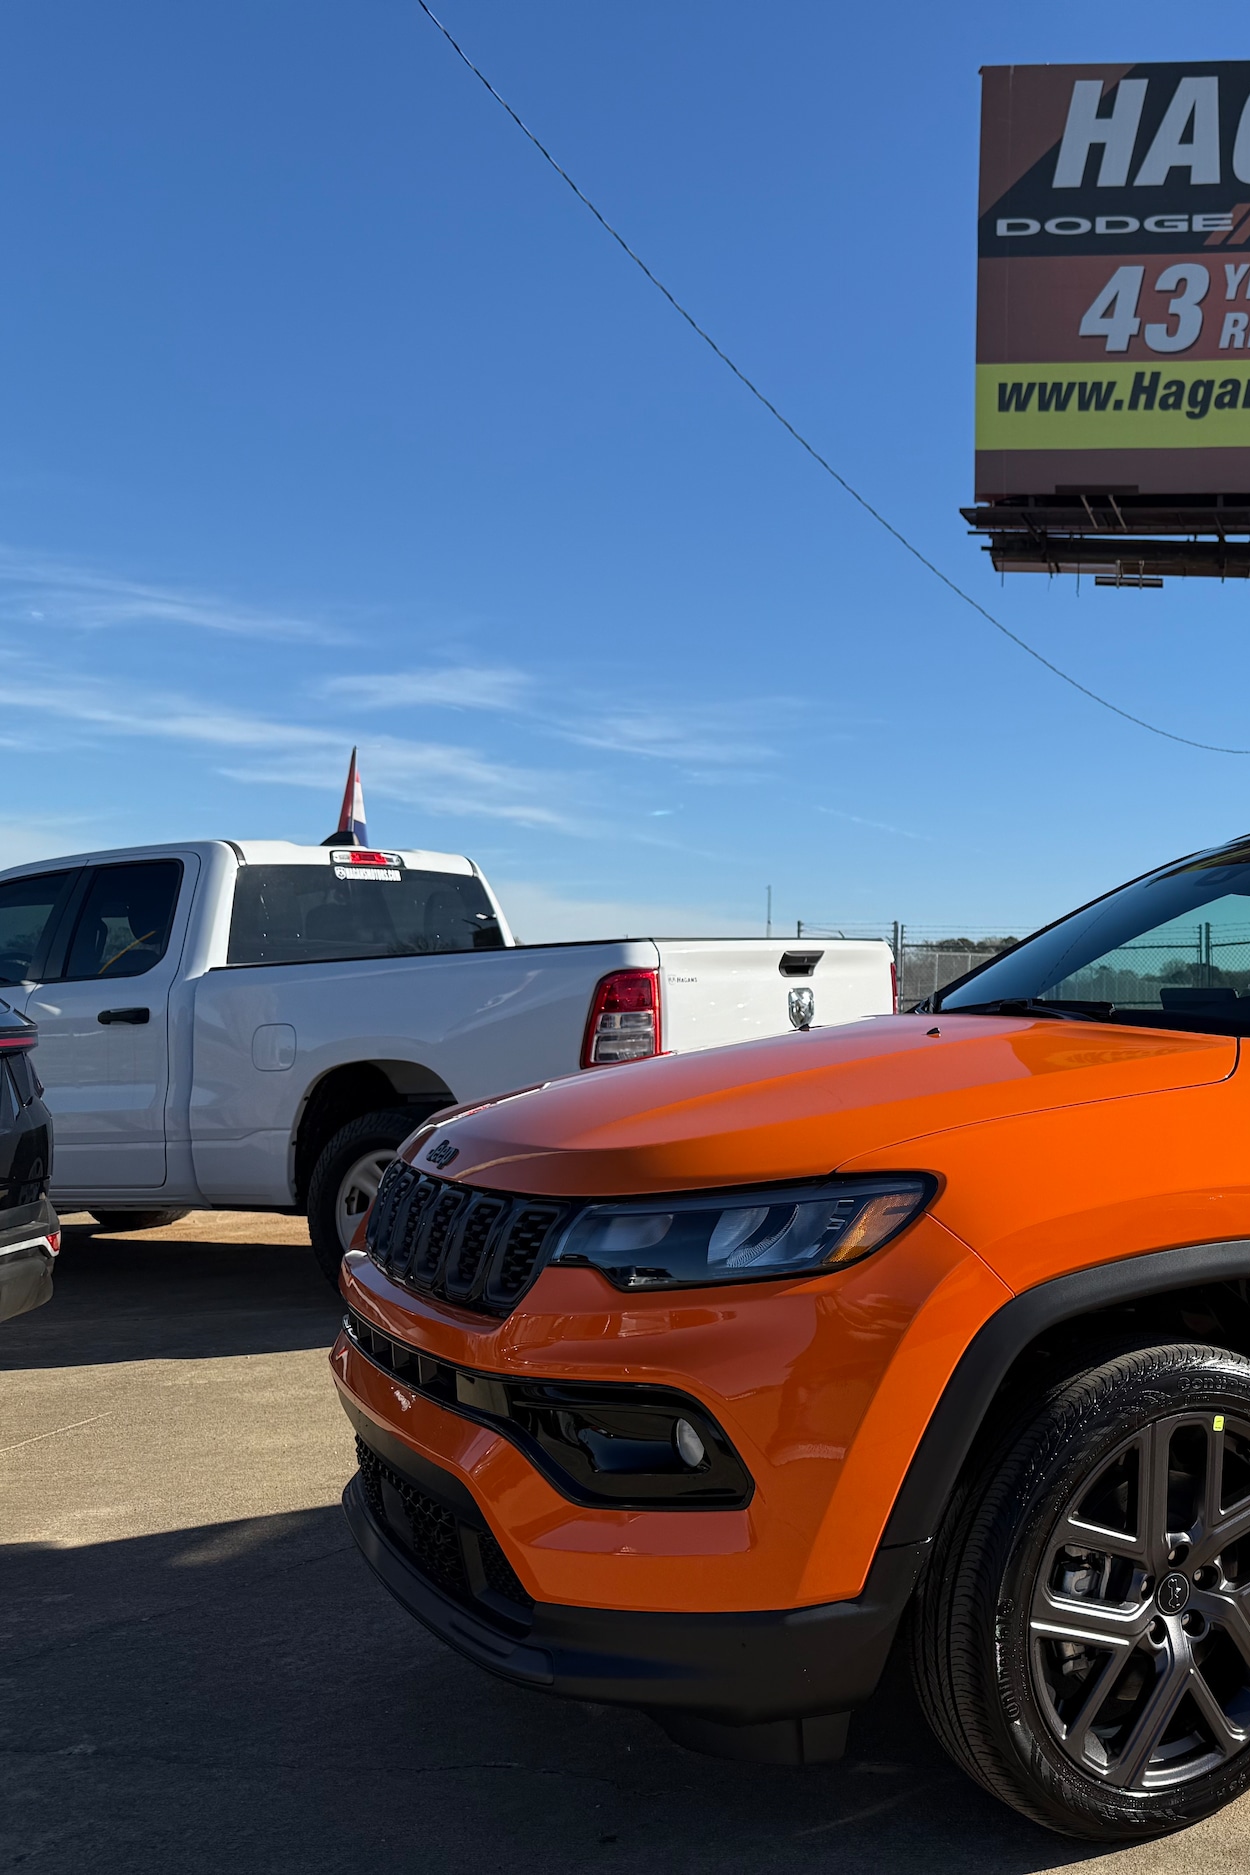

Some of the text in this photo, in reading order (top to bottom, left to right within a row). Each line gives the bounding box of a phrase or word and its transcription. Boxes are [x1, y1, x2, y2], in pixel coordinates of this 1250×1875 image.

[996, 213, 1234, 237] DODGE
[1078, 263, 1210, 352] 43
[426, 1139, 459, 1170] Jeep
